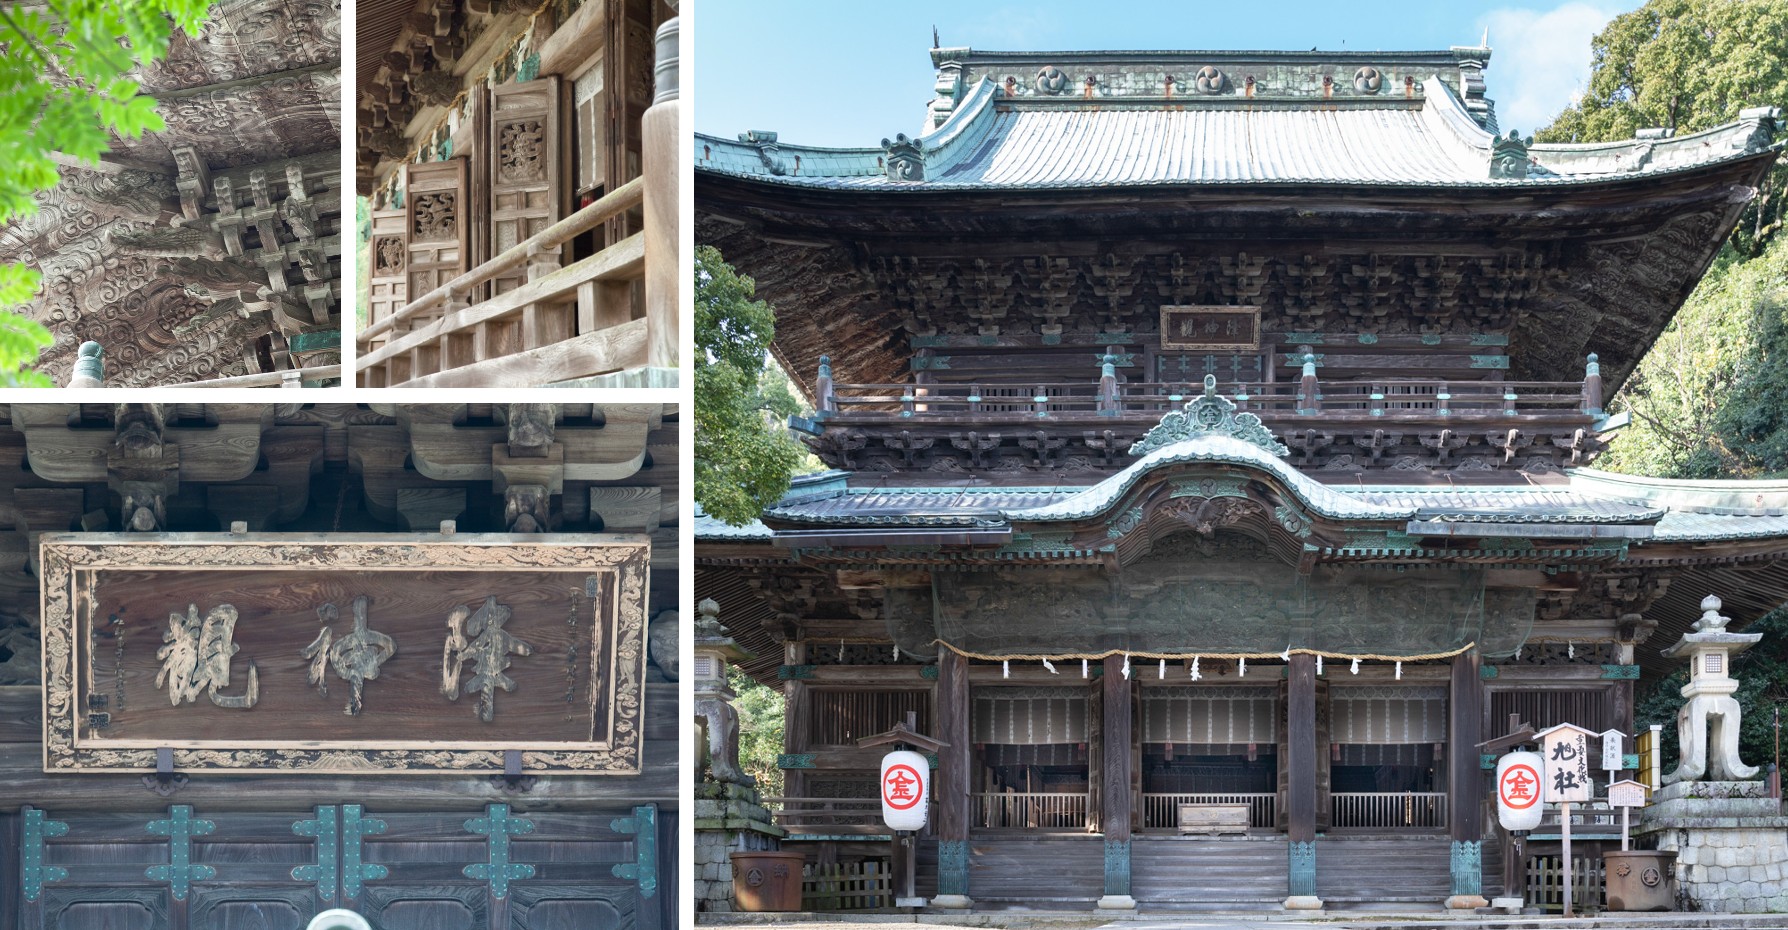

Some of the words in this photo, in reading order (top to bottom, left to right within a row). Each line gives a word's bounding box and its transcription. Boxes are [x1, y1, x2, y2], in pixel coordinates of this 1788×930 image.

[1551, 741, 1580, 795] 旭社
[886, 769, 917, 801] 金
[1504, 769, 1536, 801] 金
